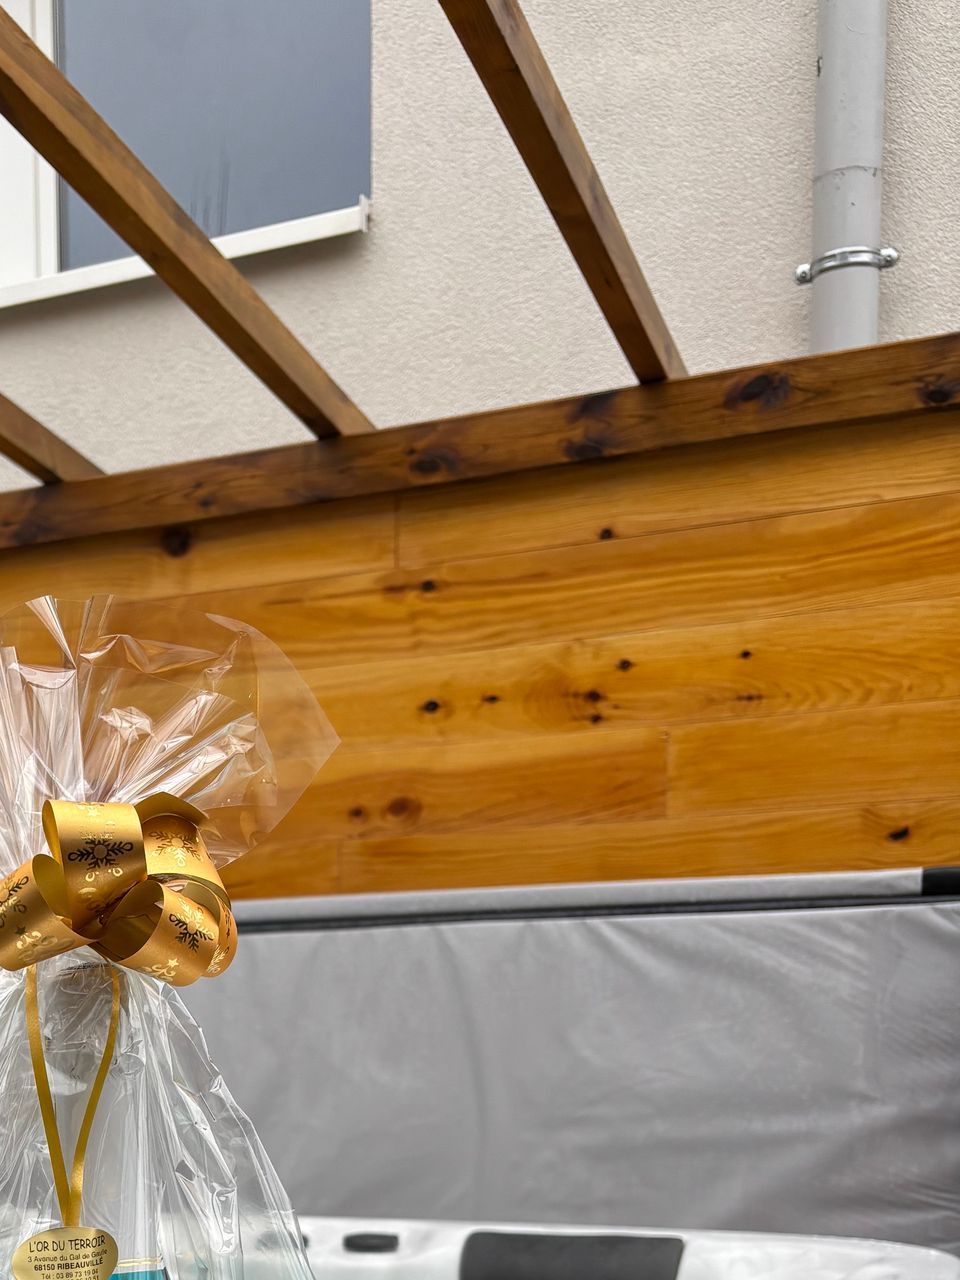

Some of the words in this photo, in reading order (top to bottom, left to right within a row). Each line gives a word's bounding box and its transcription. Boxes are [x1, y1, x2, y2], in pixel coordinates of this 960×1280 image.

[29, 1240, 49, 1253] L'OR
[52, 1241, 65, 1252] DU
[68, 1235, 105, 1250] TERROIR
[82, 1252, 90, 1260] de
[34, 1263, 55, 1272] 68150
[74, 1270, 82, 1278] 73
